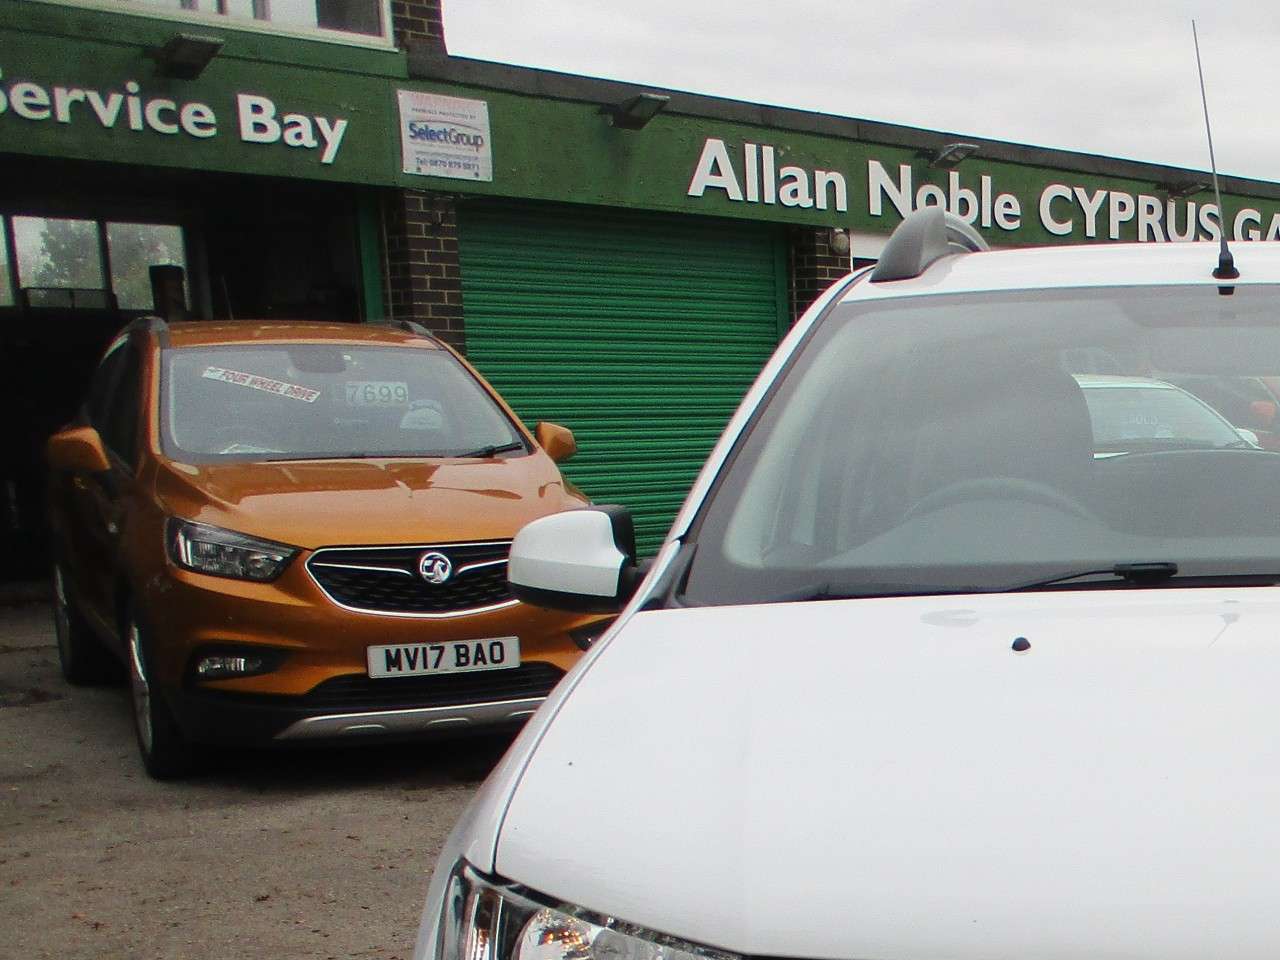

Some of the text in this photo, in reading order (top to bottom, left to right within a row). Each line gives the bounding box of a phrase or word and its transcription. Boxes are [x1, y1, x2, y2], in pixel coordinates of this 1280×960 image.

[0, 68, 348, 164] ervice Bay
[408, 122, 484, 152] SelectGroup
[687, 138, 848, 212] Allan
[868, 159, 1022, 231] Noble
[1039, 184, 1222, 242] CYPRUS
[385, 641, 505, 672] MV17 BAO
